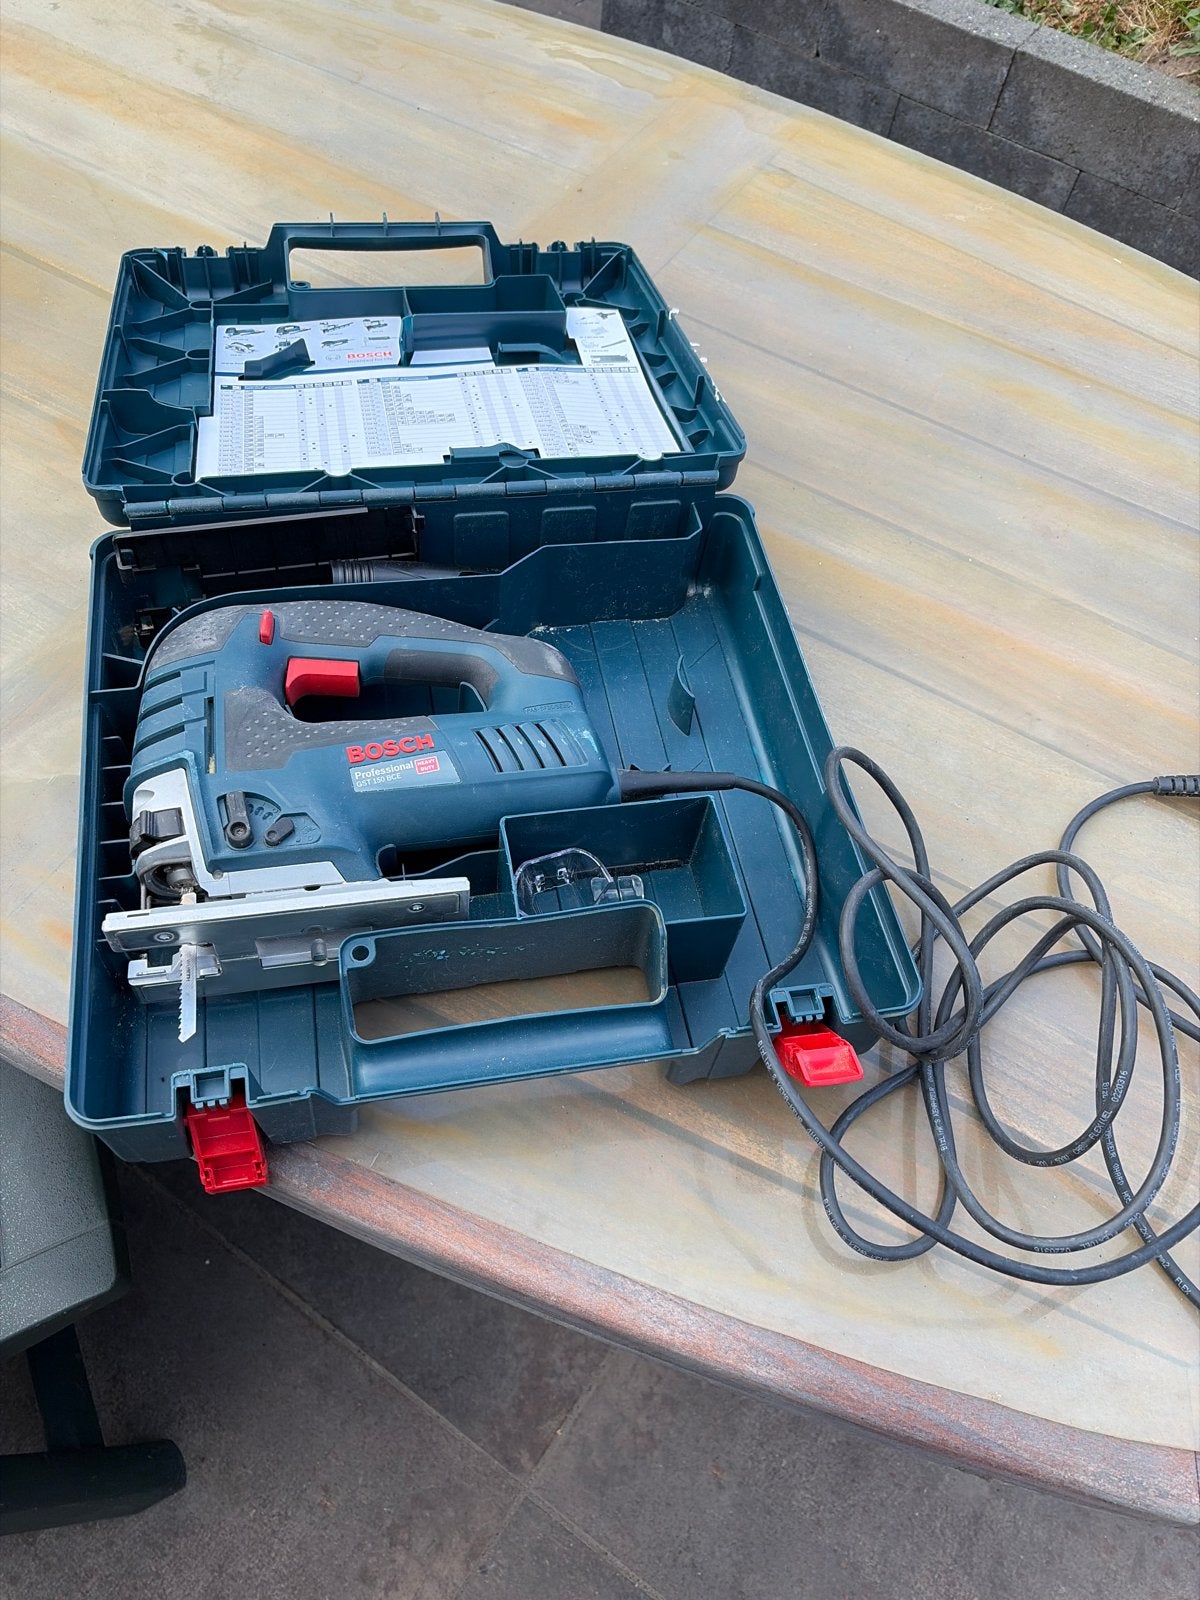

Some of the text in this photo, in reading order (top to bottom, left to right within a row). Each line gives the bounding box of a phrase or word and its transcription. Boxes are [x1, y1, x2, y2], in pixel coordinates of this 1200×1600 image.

[347, 351, 392, 359] BOSCH
[346, 734, 435, 764] BOSCH
[417, 758, 436, 766] HEAVY
[420, 764, 436, 772] DUTY
[354, 761, 414, 780] Professional
[356, 779, 372, 788] GST
[386, 772, 402, 782] BCE
[1111, 1070, 1128, 1103] 0220316
